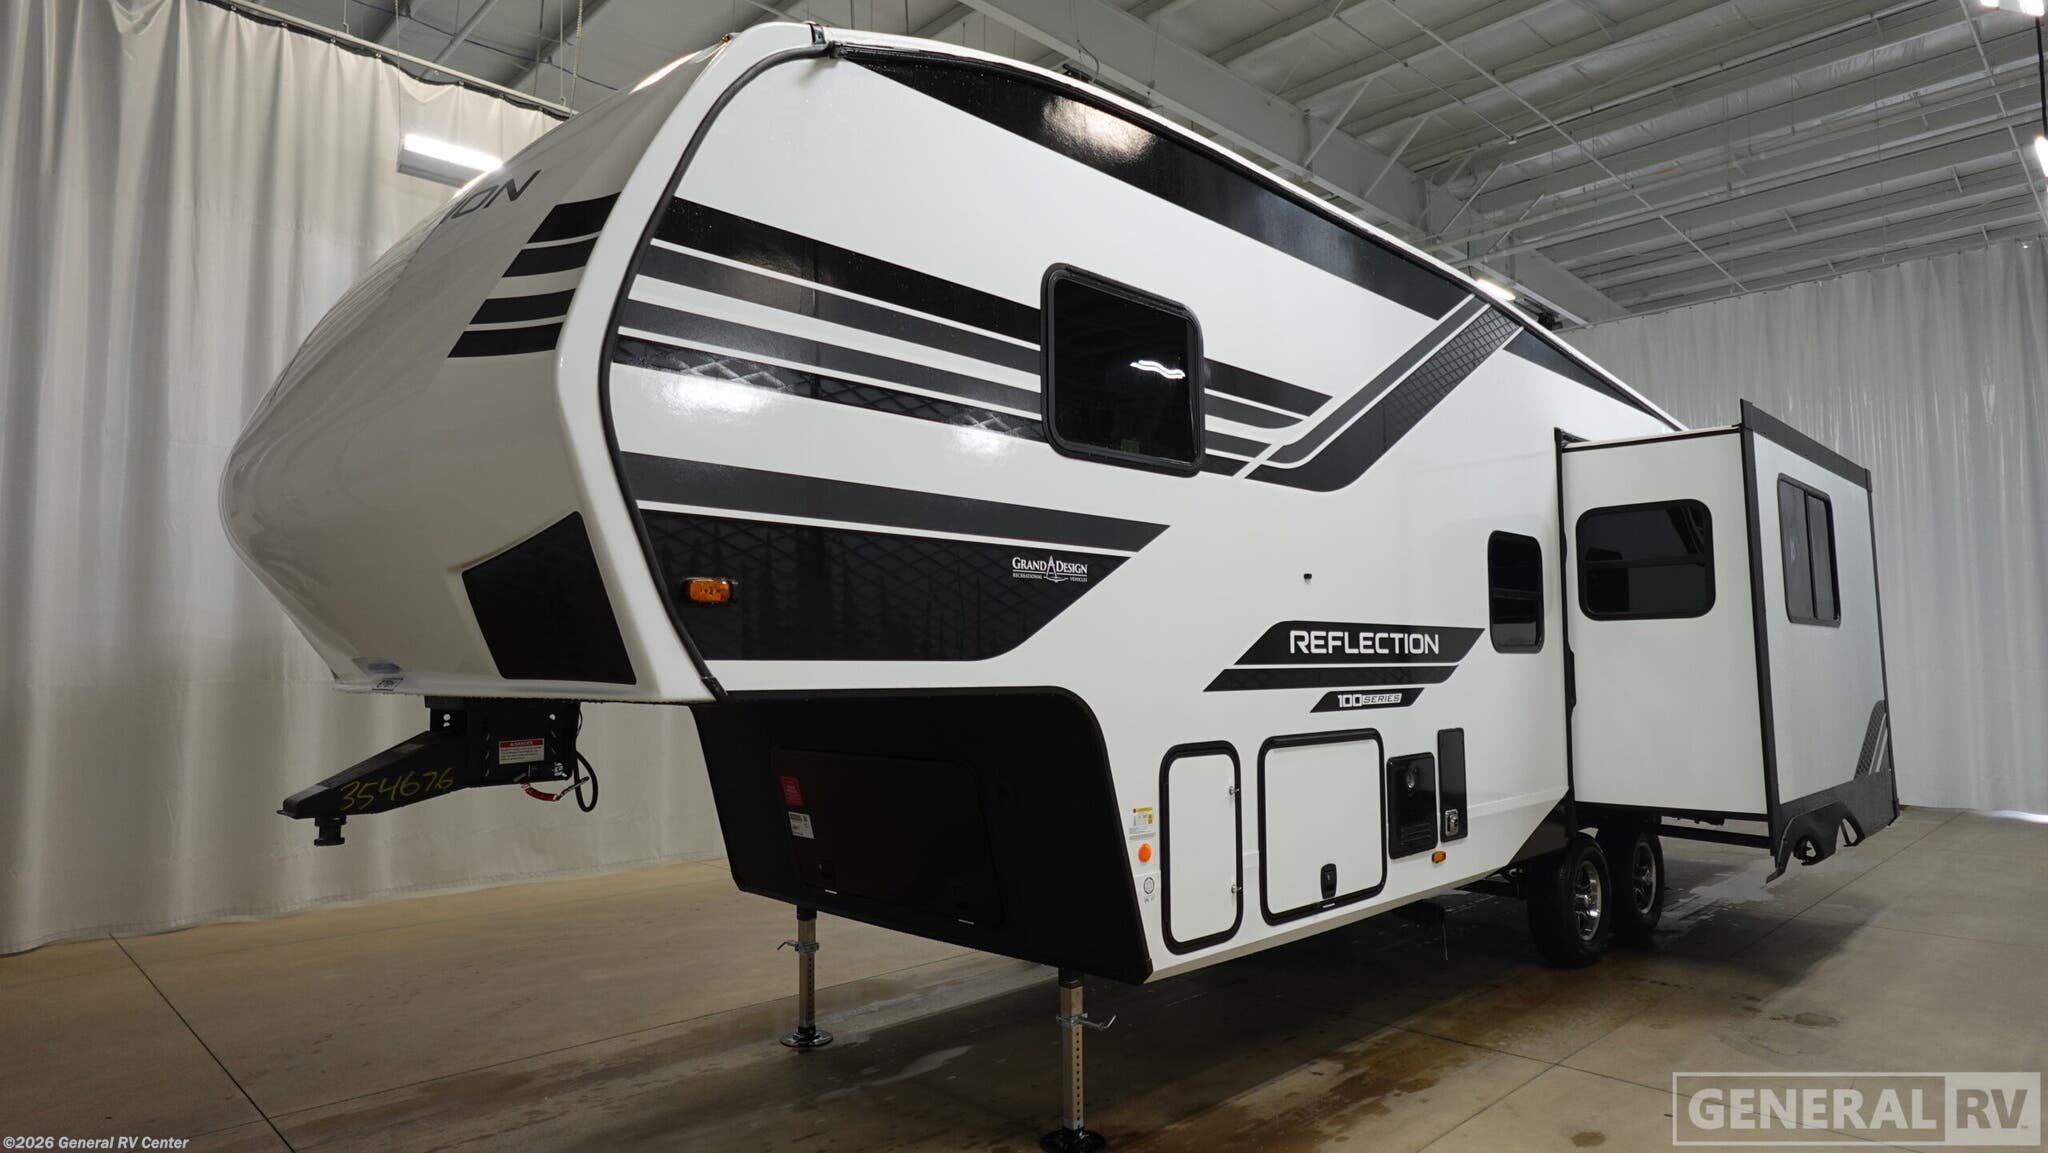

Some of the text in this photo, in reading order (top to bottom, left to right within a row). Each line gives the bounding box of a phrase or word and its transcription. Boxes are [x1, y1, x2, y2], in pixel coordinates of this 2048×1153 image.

[1012, 557, 1088, 574] GRAND DESIGN
[1290, 630, 1439, 654] REFLECTION
[1338, 694, 1401, 708] 100 SERIES
[339, 768, 455, 812] 354676
